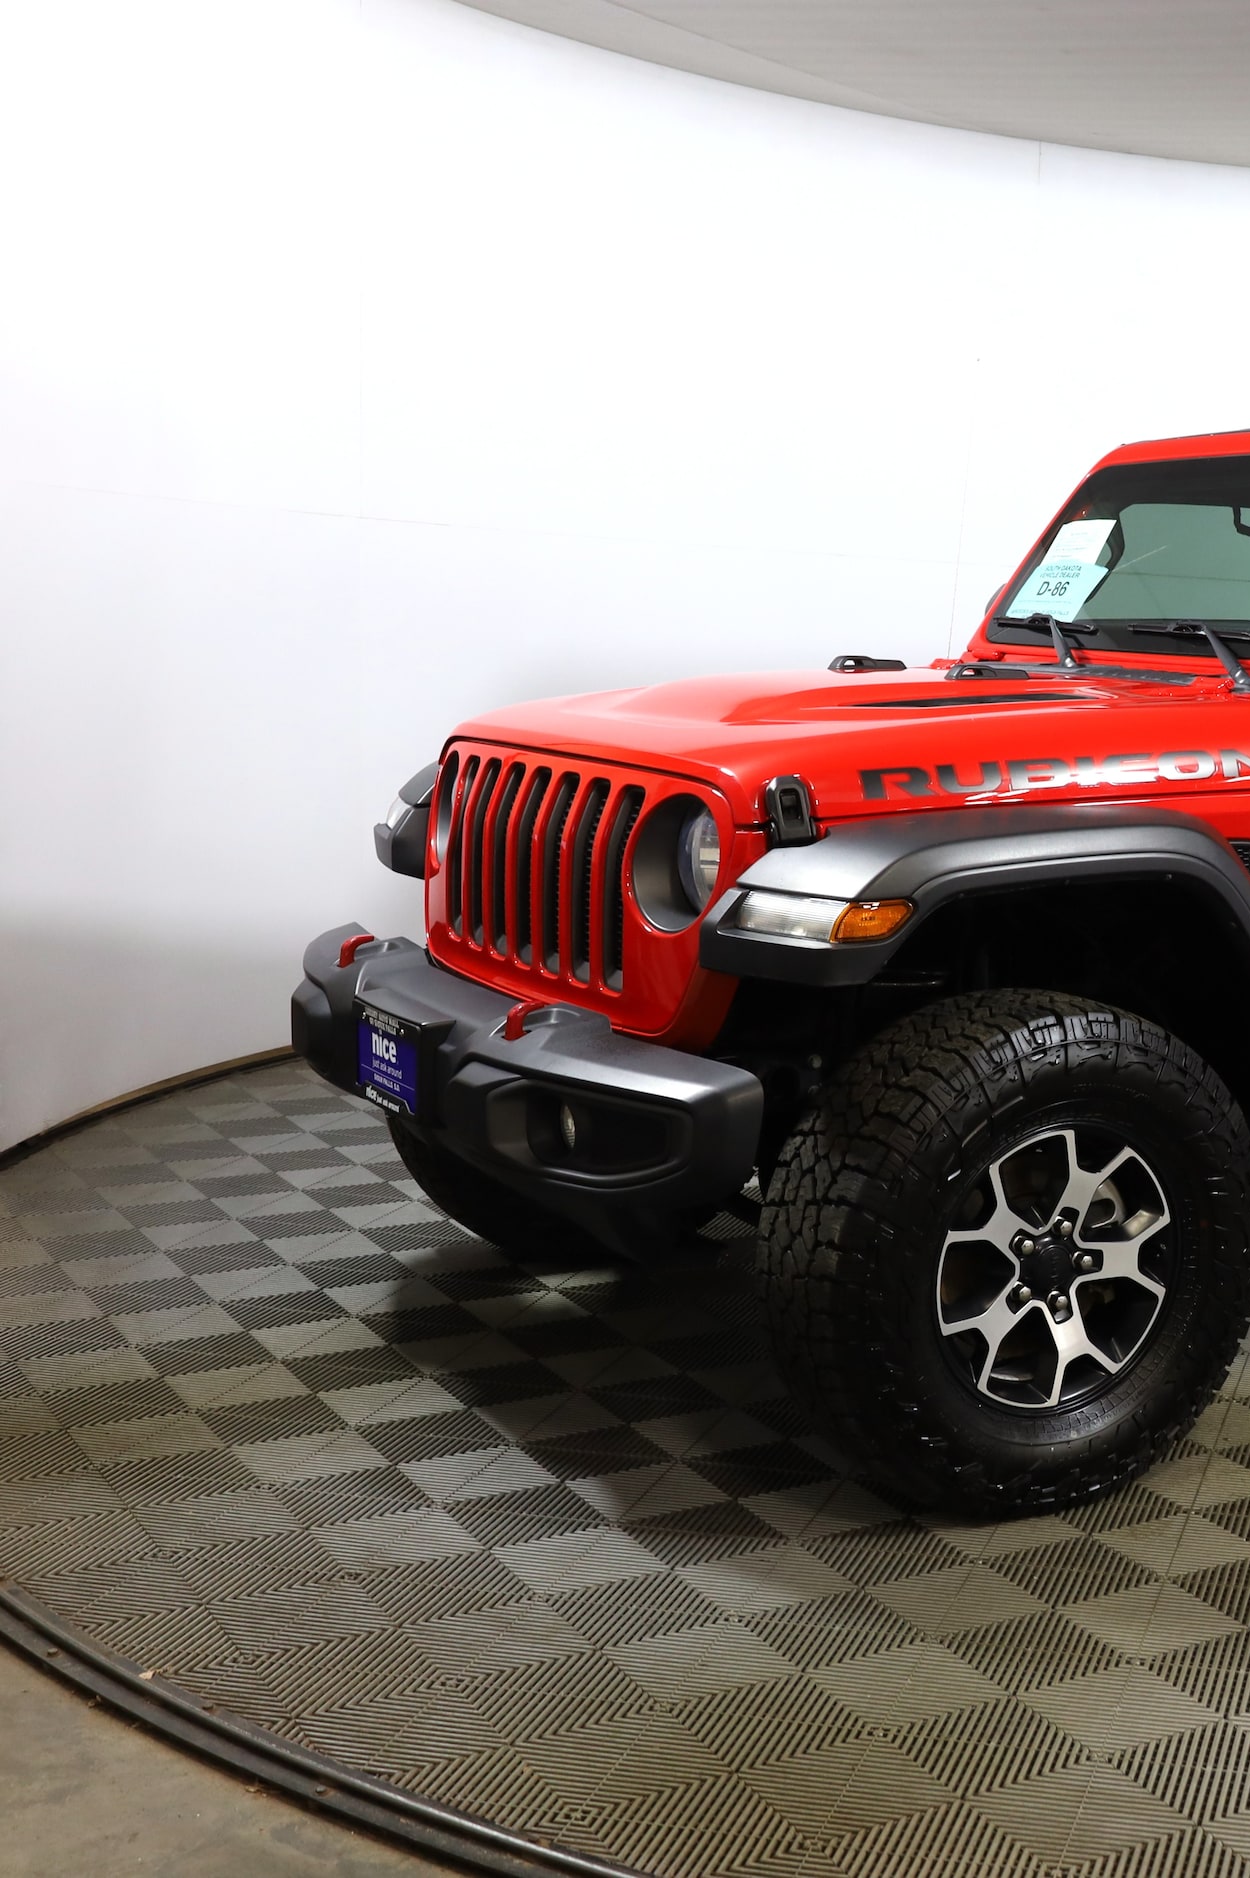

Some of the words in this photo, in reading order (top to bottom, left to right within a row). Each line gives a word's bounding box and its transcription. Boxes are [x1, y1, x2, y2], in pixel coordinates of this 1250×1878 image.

[1036, 581, 1070, 597] D-86
[371, 1029, 397, 1064] nice
[372, 1056, 380, 1069] just
[387, 1066, 402, 1080] around
